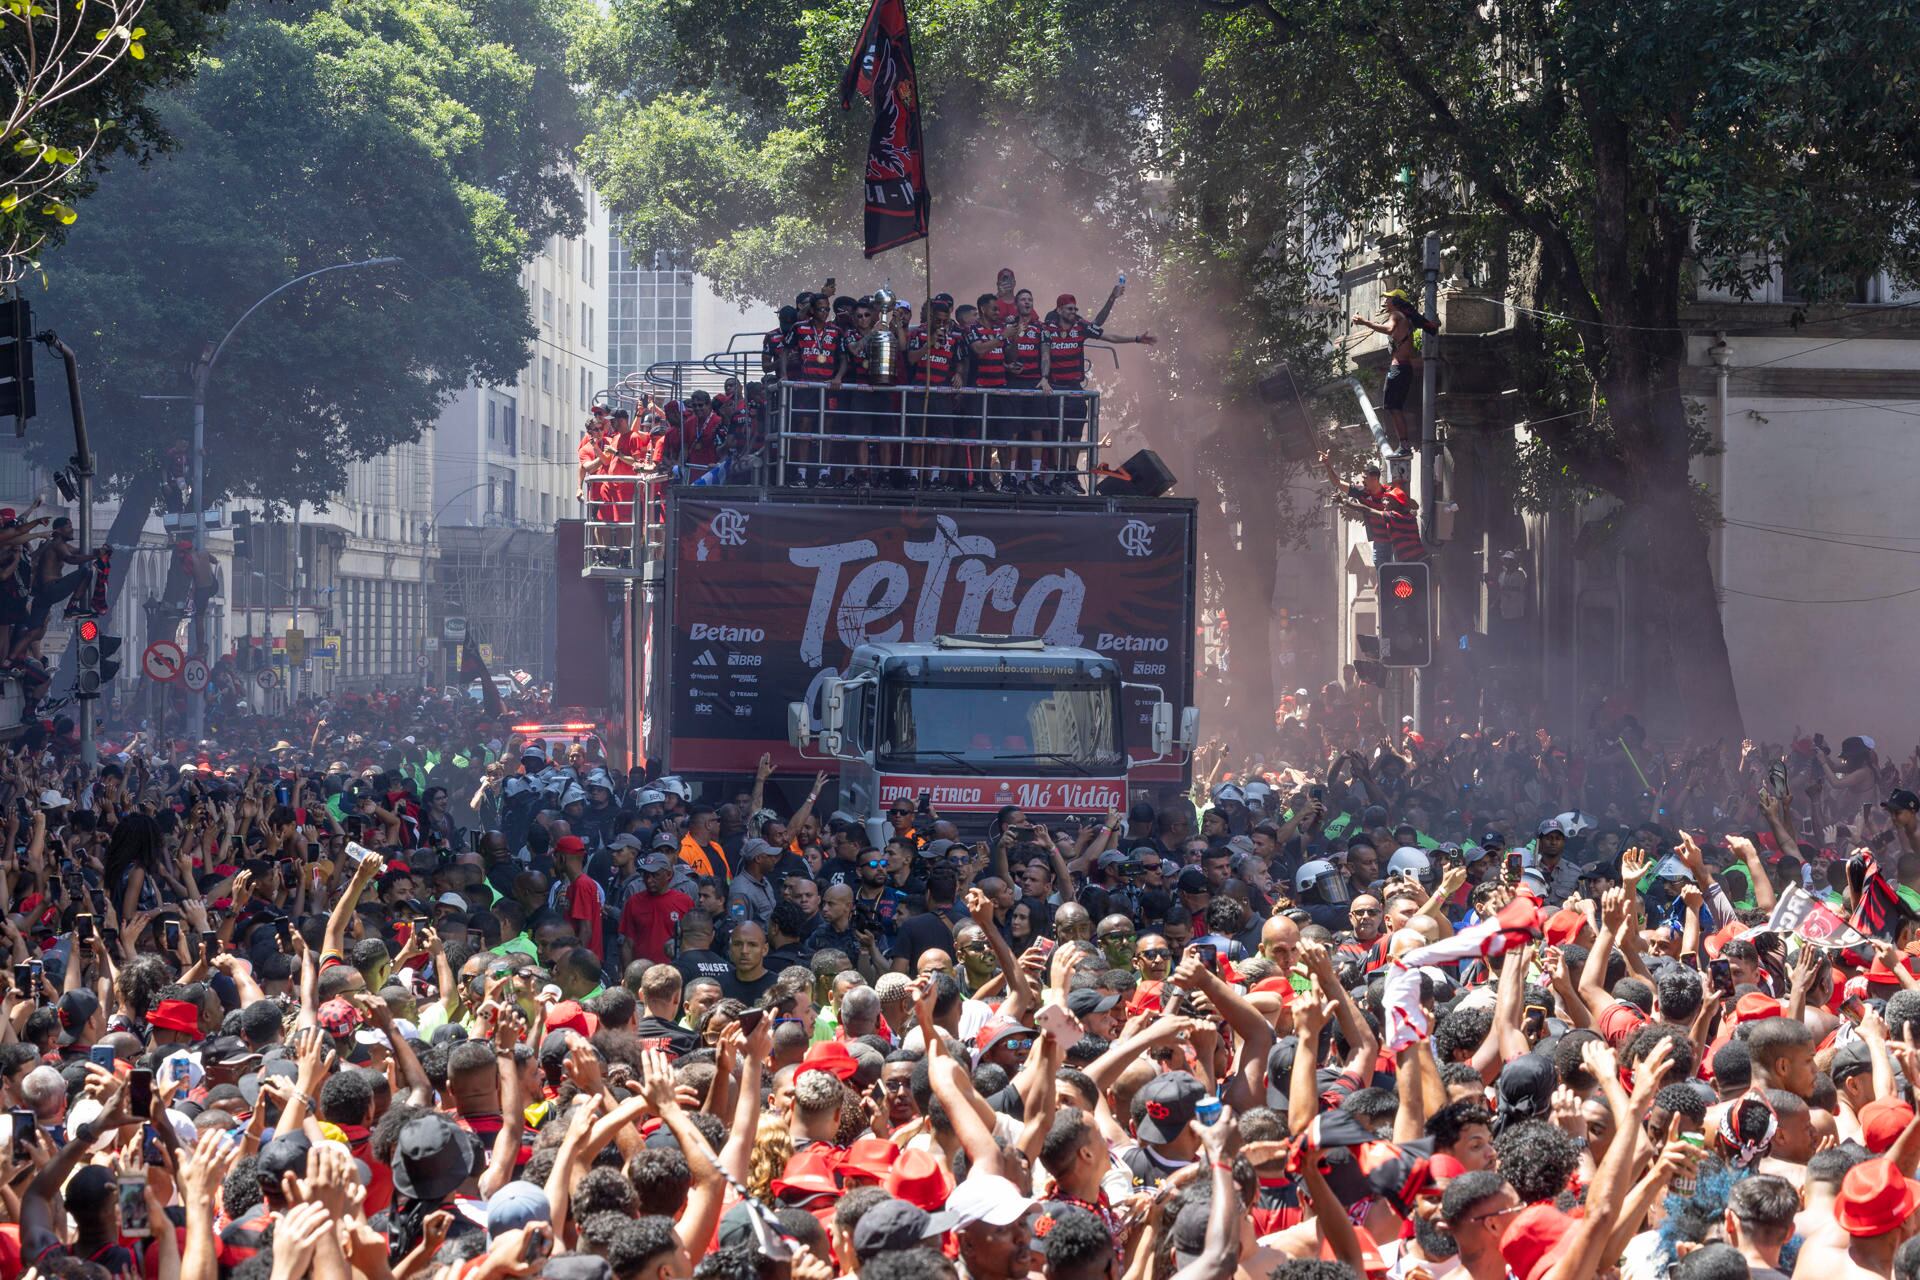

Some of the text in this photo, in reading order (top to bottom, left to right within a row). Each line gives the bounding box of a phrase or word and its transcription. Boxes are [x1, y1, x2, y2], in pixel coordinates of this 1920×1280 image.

[789, 514, 1086, 668] Tetra
[689, 623, 765, 642] Betano
[1096, 633, 1169, 651] Betano
[739, 655, 762, 666] BRB
[187, 667, 205, 681] 60
[1143, 664, 1166, 675] BRB
[881, 786, 912, 802] TRIO
[1018, 783, 1052, 808] Mó
[1057, 783, 1121, 808] Vidão
